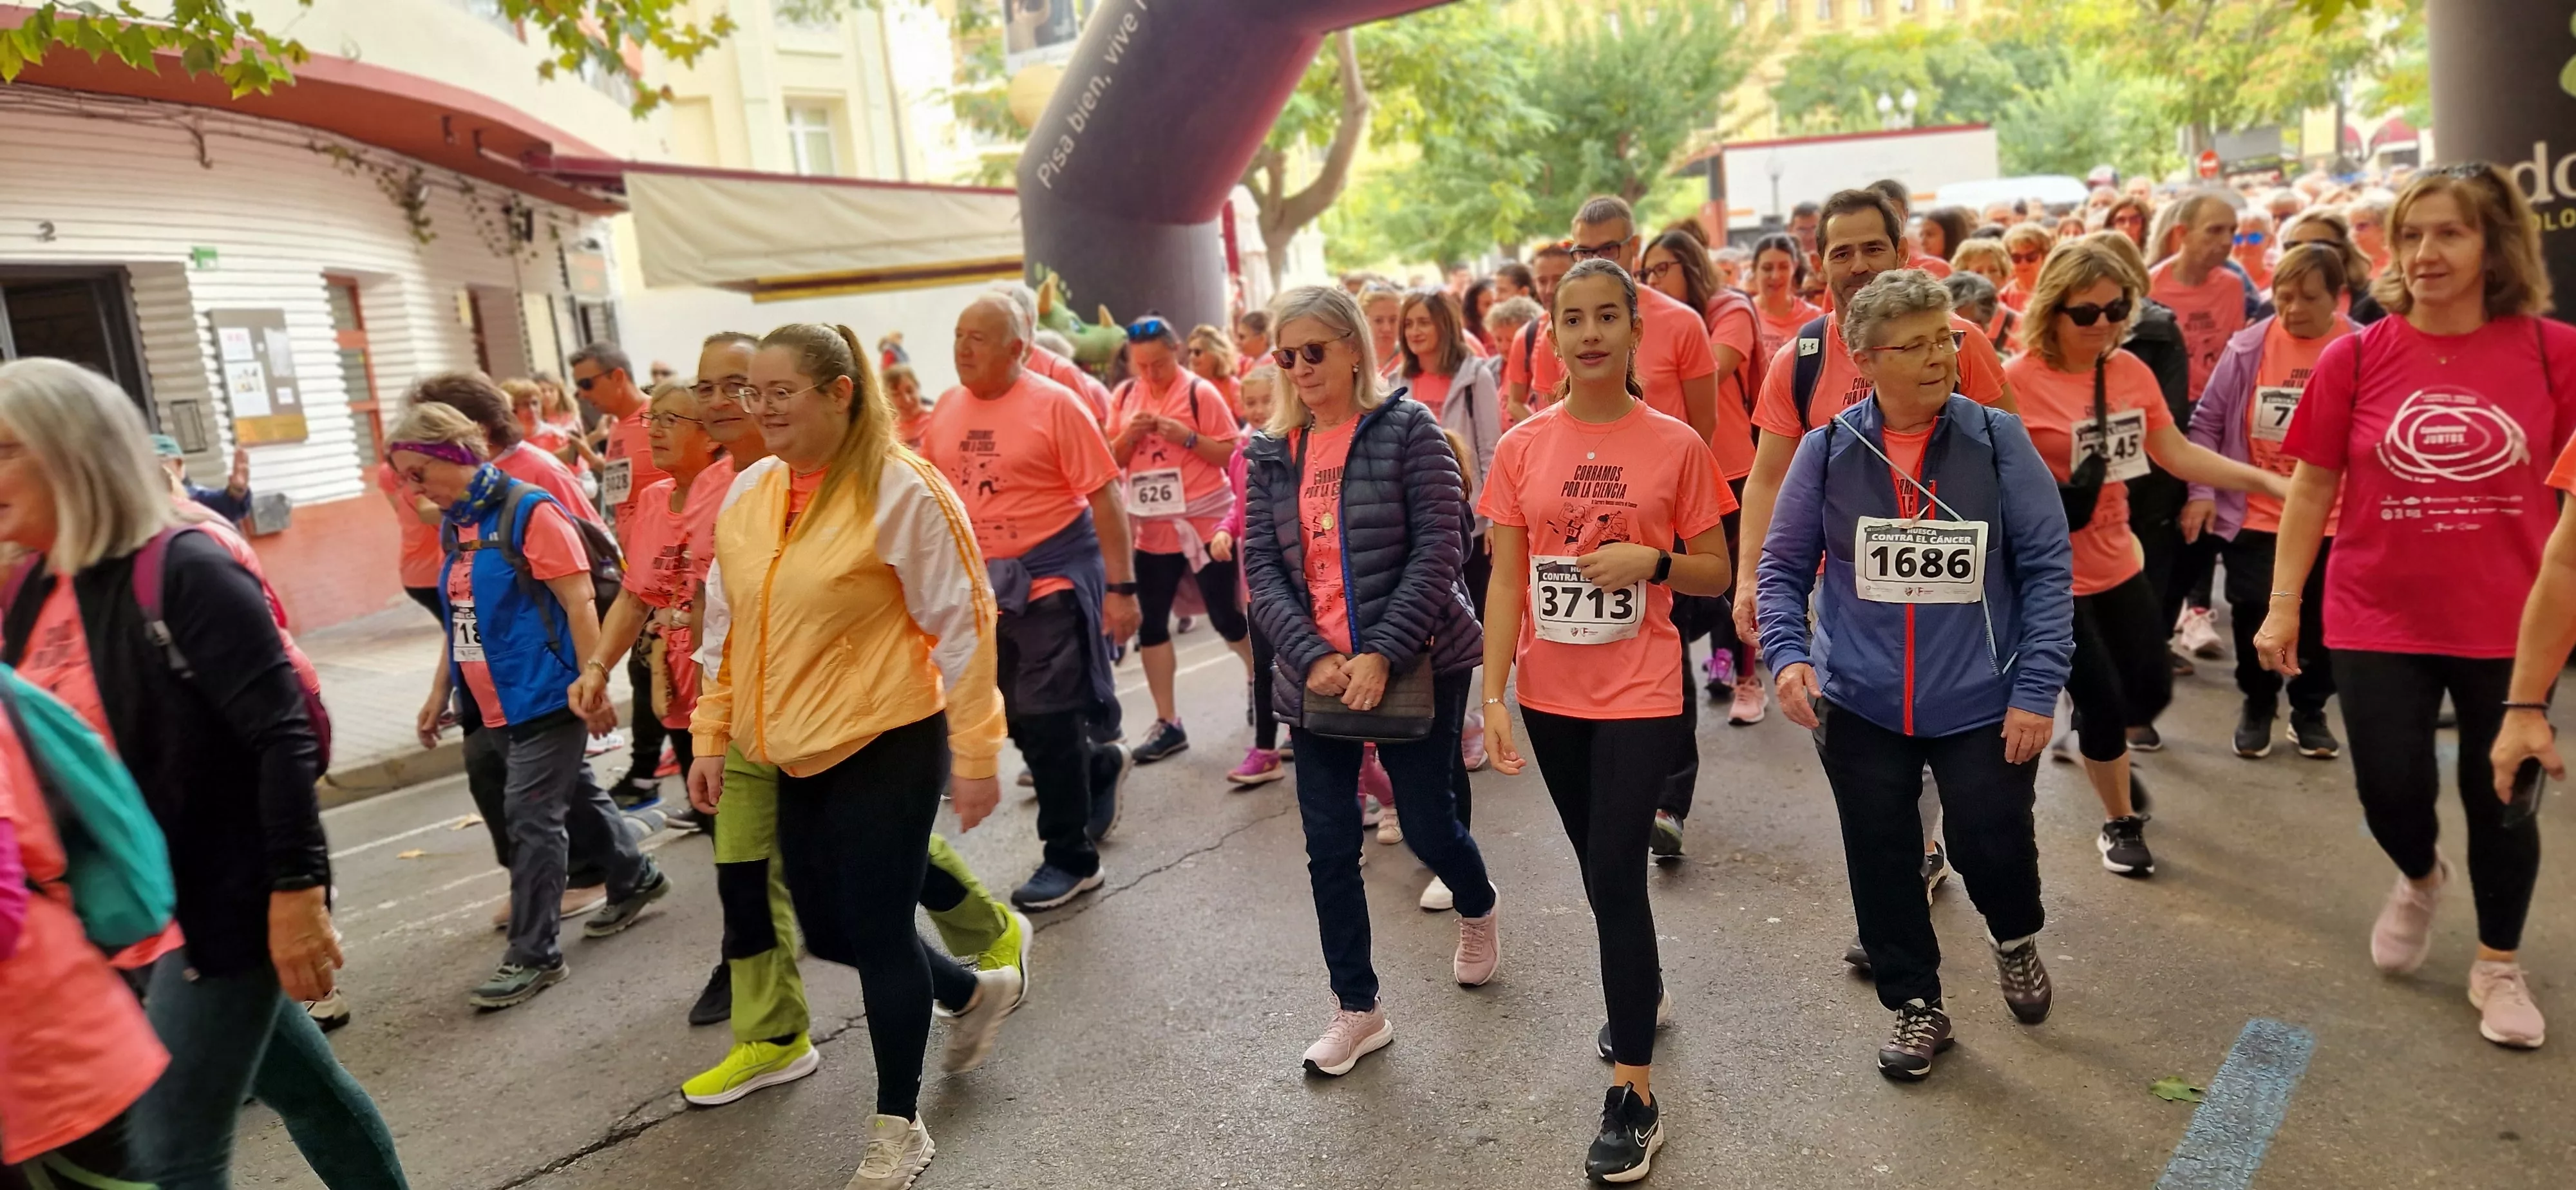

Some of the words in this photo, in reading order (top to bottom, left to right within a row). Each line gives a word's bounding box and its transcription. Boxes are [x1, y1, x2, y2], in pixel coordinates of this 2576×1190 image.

[1037, 134, 1075, 190] Pisa
[1066, 75, 1112, 134] bien,
[1104, 12, 1139, 64] vive
[38, 222, 57, 243] 2
[1842, 390, 1858, 406] POR
[1573, 464, 1624, 482] CORRAMOS
[1139, 484, 1172, 504] 626
[1560, 481, 1580, 498] POR
[1580, 482, 1592, 498] LA
[1592, 482, 1627, 500] CIENCIA
[1871, 534, 1914, 542] CONTRA
[1915, 535, 1928, 543] EL
[1929, 535, 1972, 544] CÁNCER
[1907, 528, 1937, 536] HUESCA
[1870, 546, 1971, 579] 1686
[1542, 572, 1578, 581] CONTRA
[1541, 585, 1633, 619] 3713
